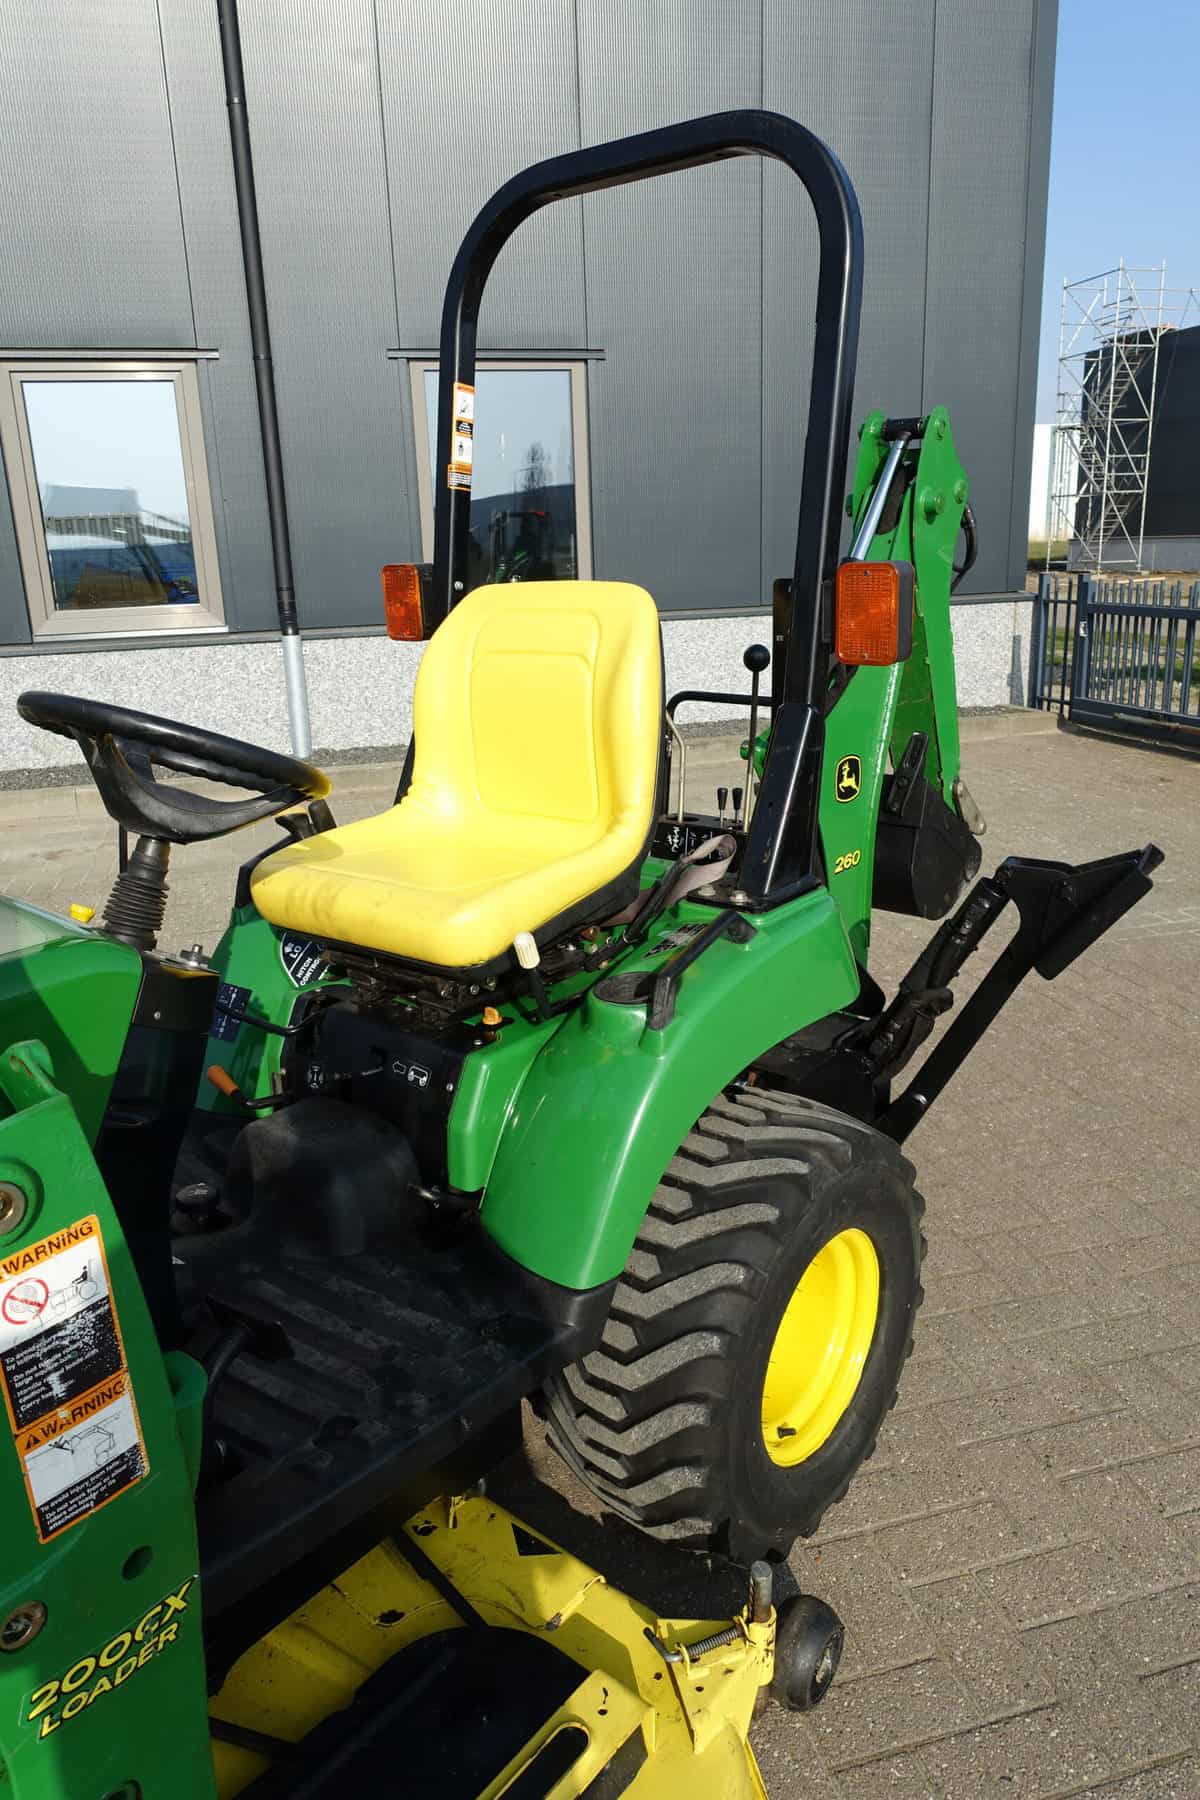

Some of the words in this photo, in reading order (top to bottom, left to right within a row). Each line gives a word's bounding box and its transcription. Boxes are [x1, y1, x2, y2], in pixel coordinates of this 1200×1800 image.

[834, 849, 861, 875] 260
[289, 944, 302, 959] LO
[2, 1220, 93, 1275] WARNING
[27, 1577, 194, 1721] 200CX
[39, 1620, 181, 1739] LOADER
